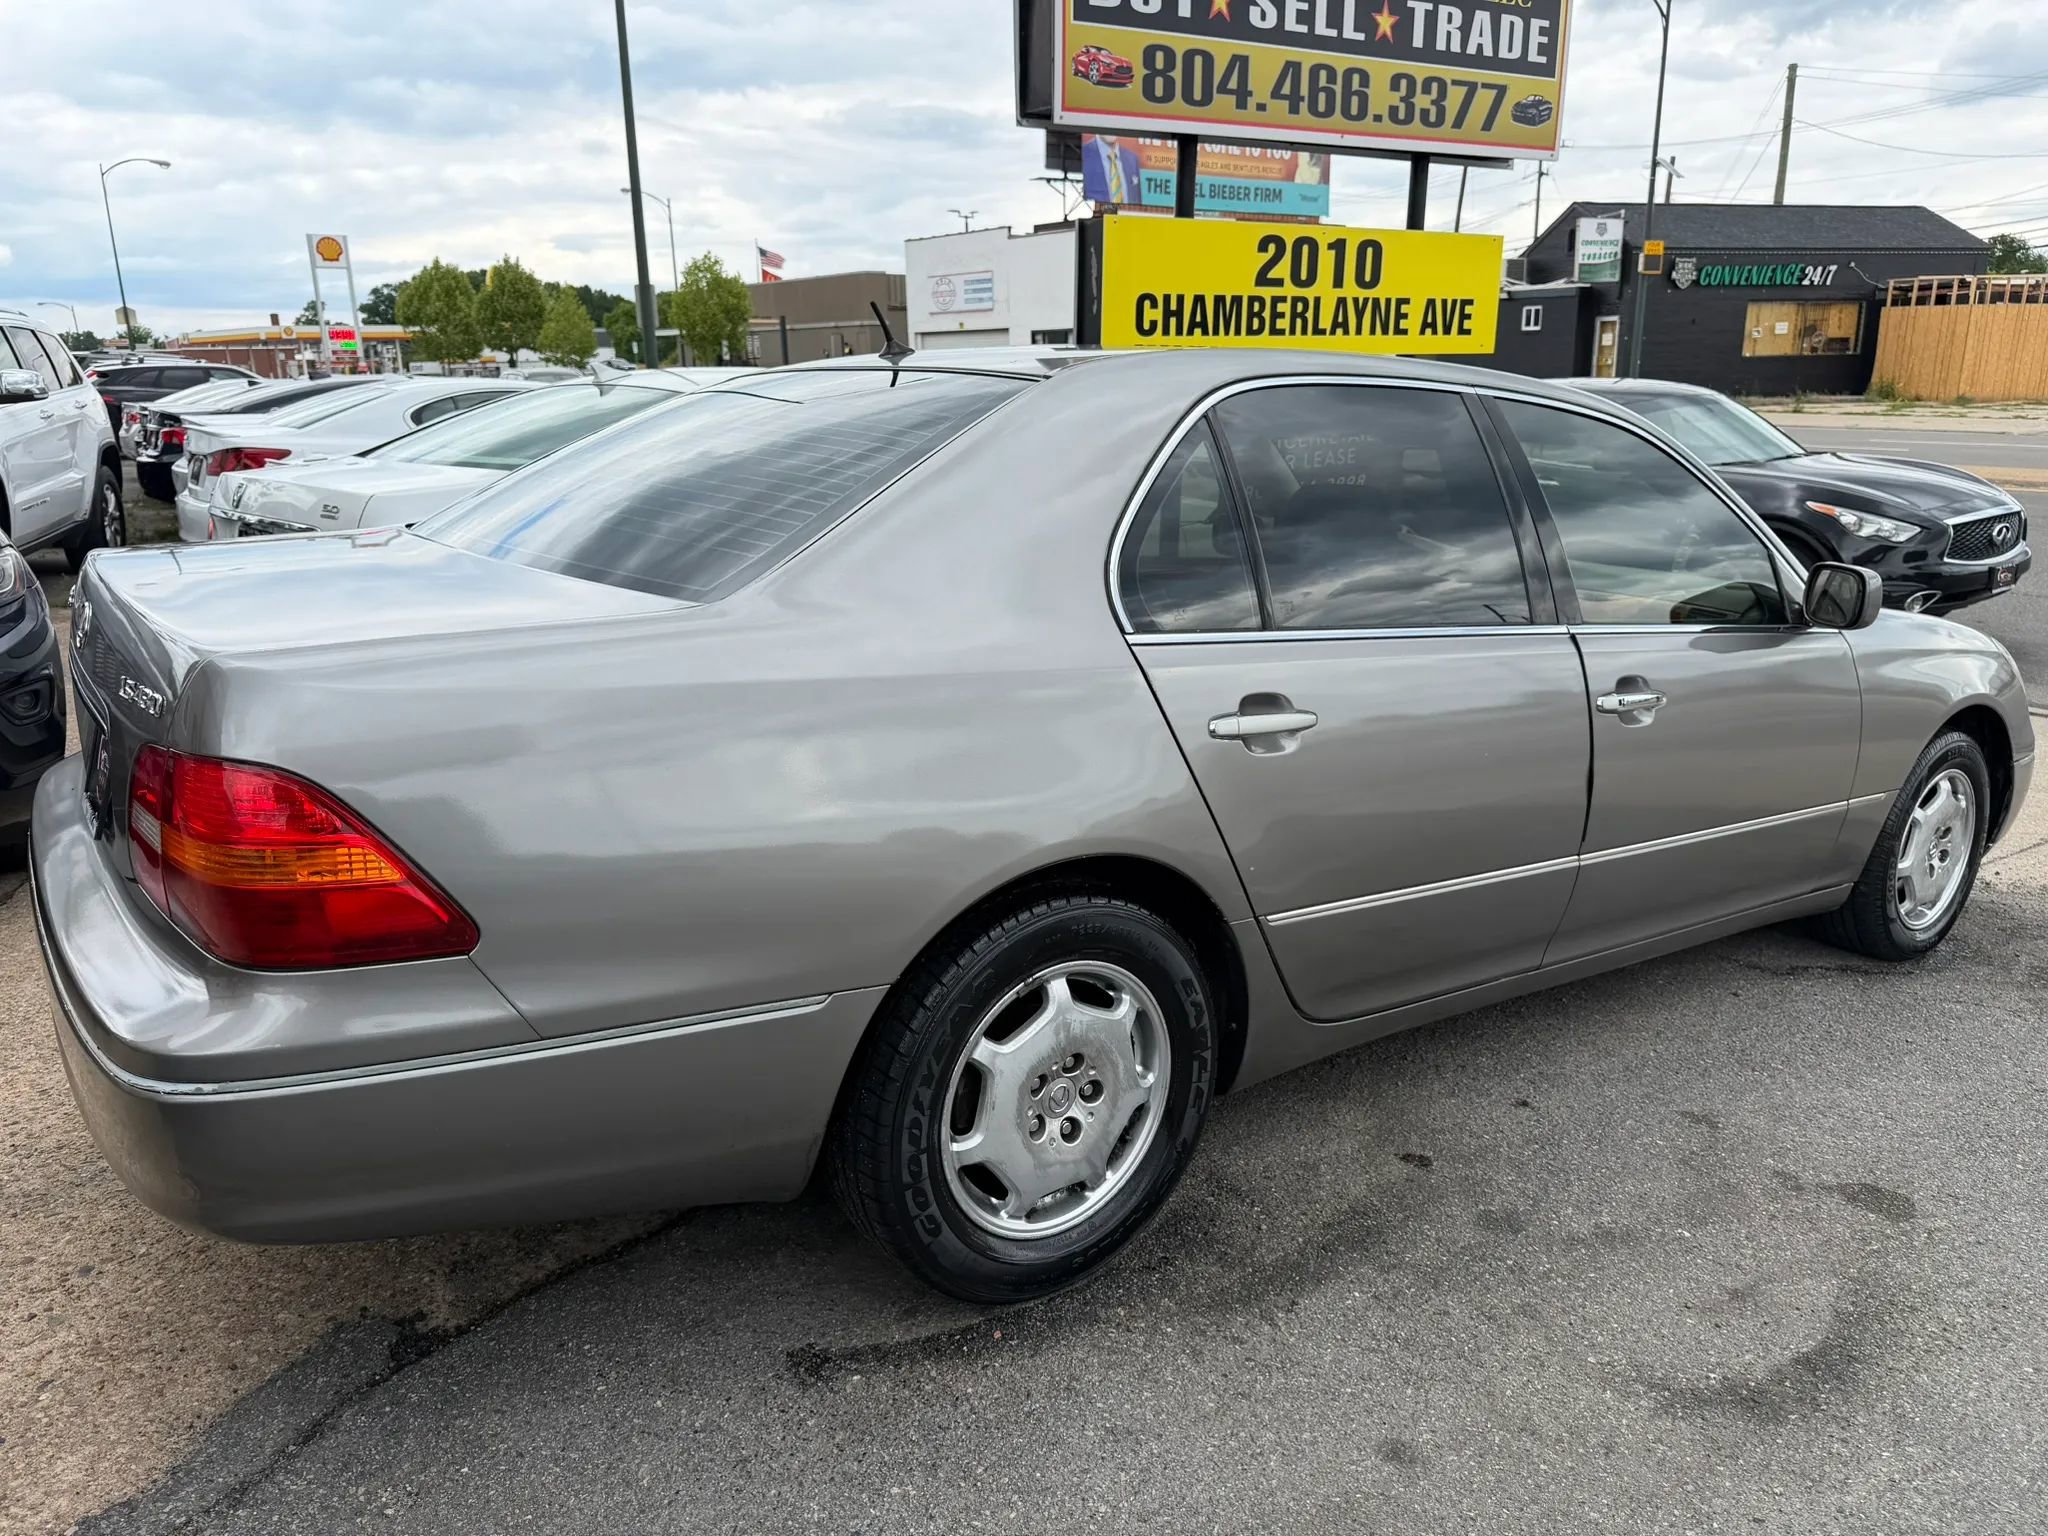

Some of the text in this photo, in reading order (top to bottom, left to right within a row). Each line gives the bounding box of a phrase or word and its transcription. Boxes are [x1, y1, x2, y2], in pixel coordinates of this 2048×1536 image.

[1249, 0, 1550, 64] SELL TRADE
[1142, 43, 1508, 133] 804.466.3377
[1145, 178, 1172, 196] THE
[1195, 182, 1206, 199] EL
[1208, 183, 1251, 201] BIEBER
[1253, 187, 1283, 203] FIRM
[1254, 233, 1384, 290] 2010
[1700, 263, 1804, 287] CONVENIENCE
[1800, 264, 1839, 286] 24/7
[1134, 291, 1474, 338] CHAMBERLAYNE AVE
